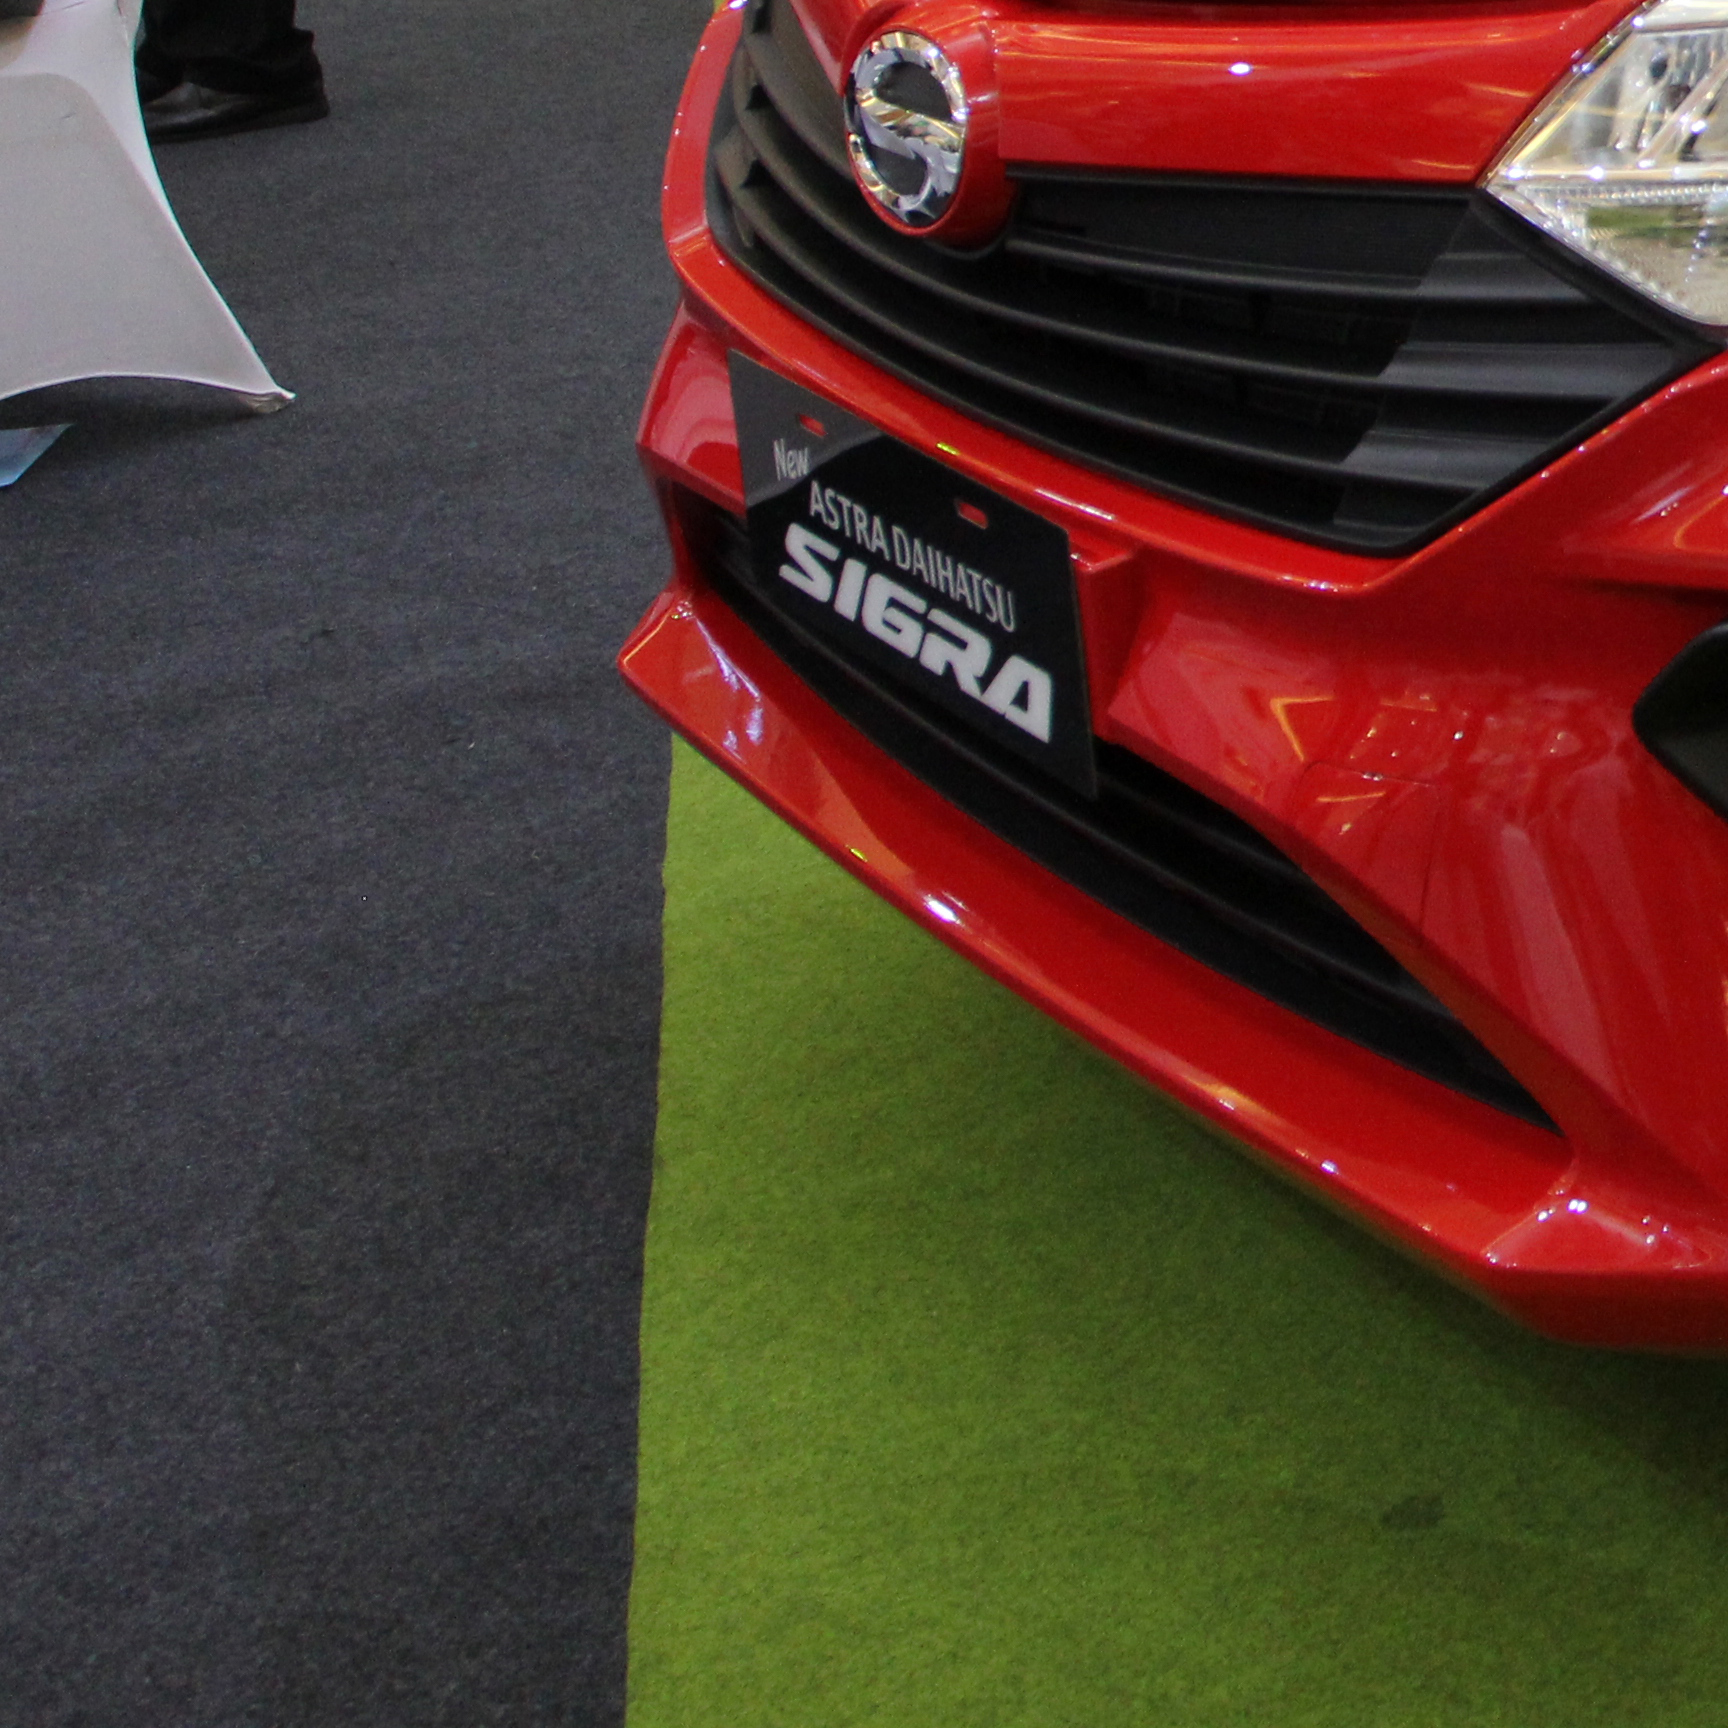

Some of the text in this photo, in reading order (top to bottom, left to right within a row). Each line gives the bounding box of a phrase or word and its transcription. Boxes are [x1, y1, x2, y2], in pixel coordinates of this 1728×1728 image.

[772, 437, 811, 481] New
[778, 522, 1054, 744] SIGRA
[808, 479, 1018, 634] ASTRA DAIHATSU
